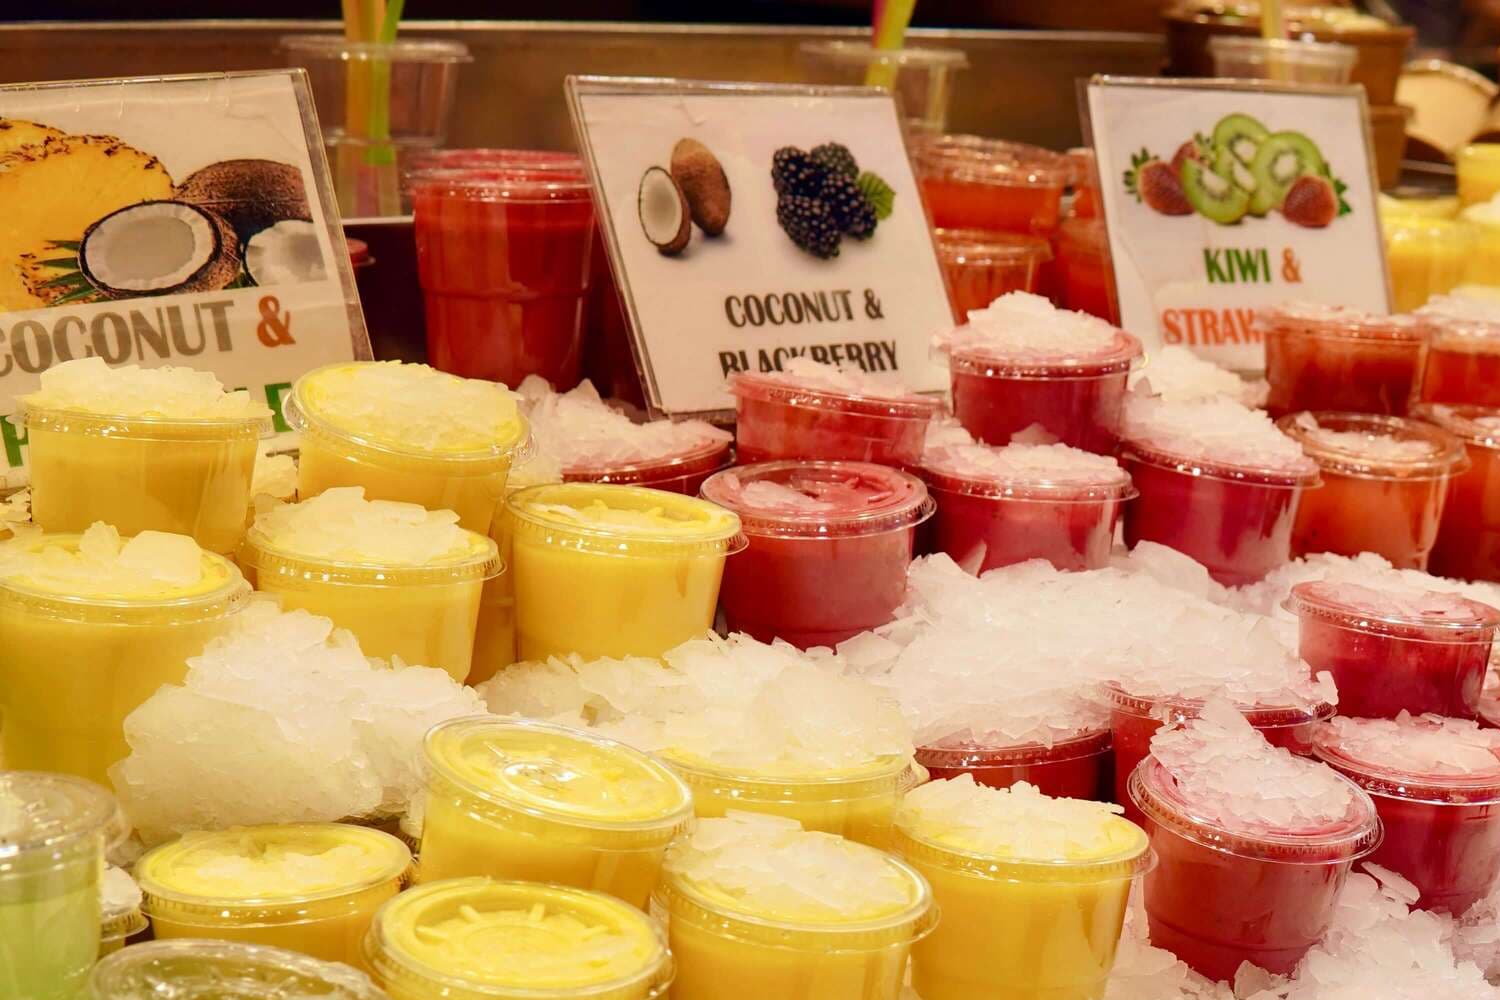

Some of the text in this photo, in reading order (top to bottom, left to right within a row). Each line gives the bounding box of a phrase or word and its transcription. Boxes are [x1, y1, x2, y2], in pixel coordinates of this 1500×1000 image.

[1203, 247, 1303, 284] KIWI &
[257, 295, 296, 348] &
[724, 288, 885, 328] COCONUT &
